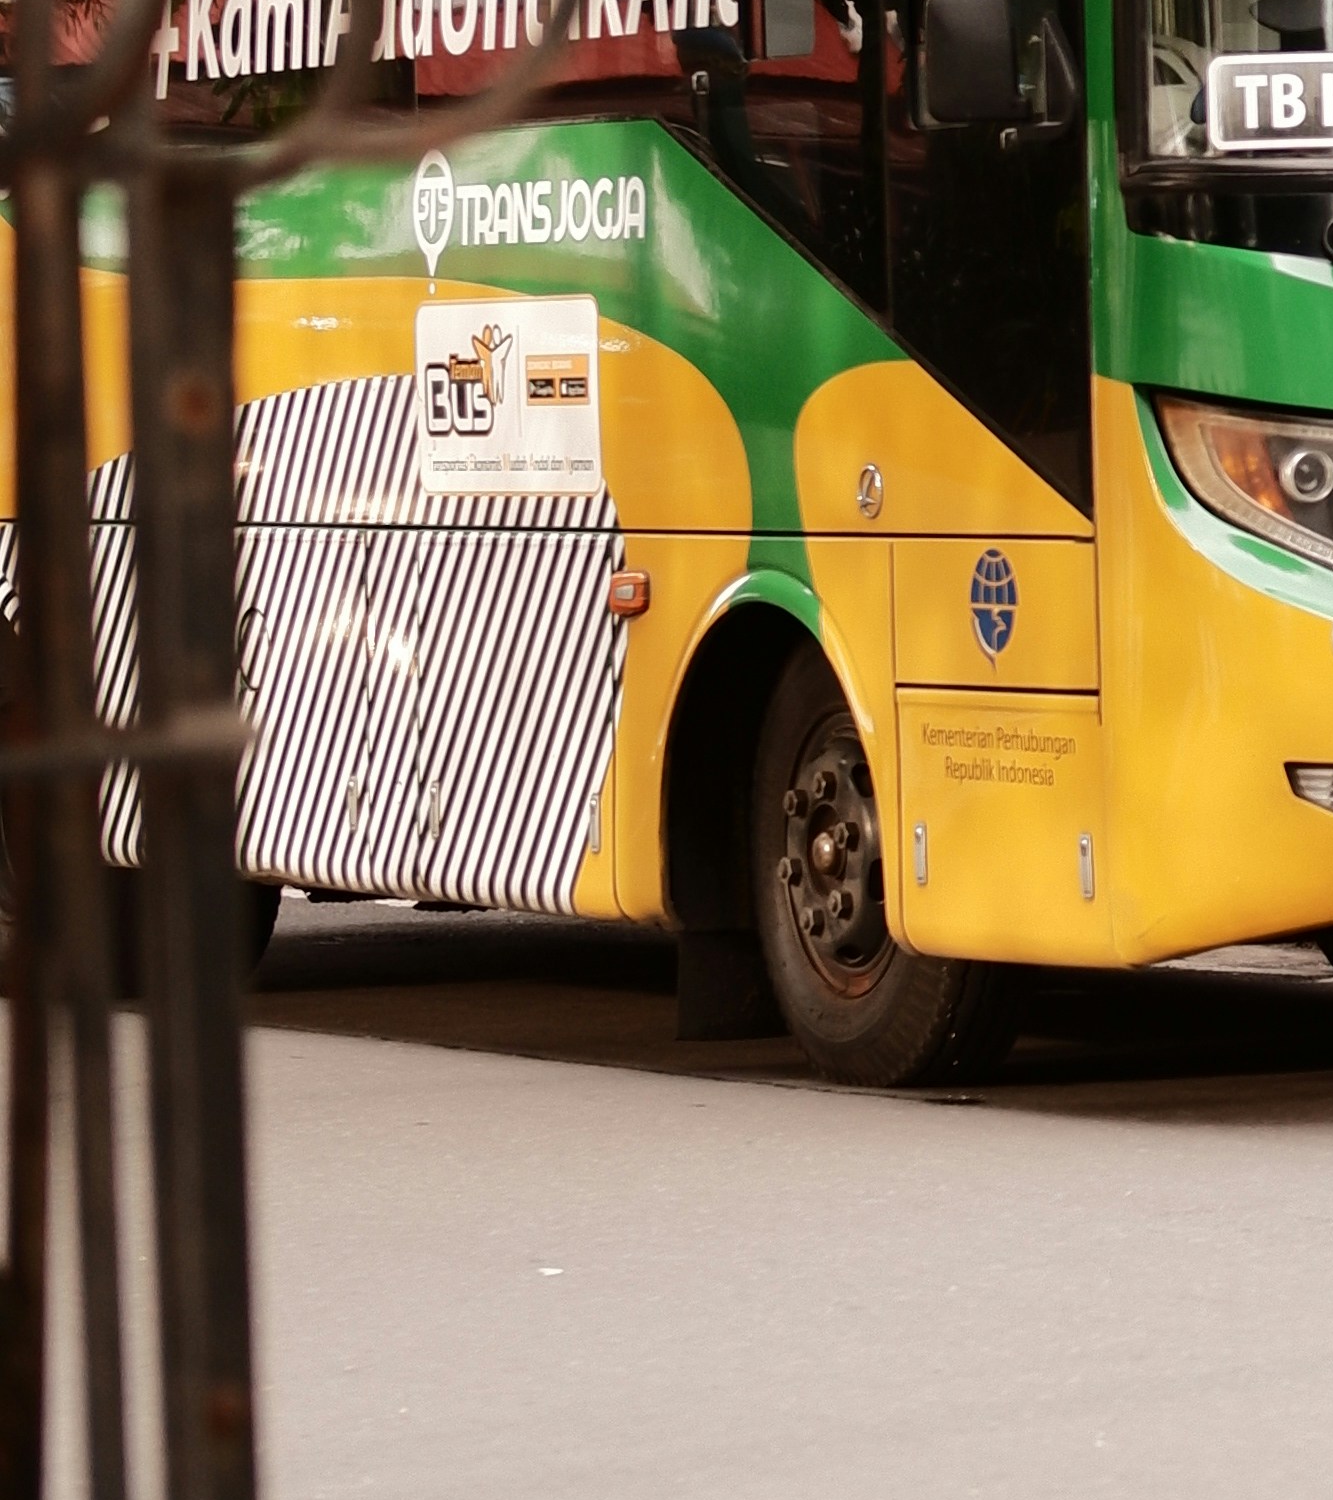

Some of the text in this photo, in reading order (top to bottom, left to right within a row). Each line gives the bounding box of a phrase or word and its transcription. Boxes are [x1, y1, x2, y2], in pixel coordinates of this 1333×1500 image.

[1234, 73, 1306, 129] TB
[922, 723, 1077, 760] Kementerian Perhubungan
[945, 756, 1055, 787] Republik Indonesia
